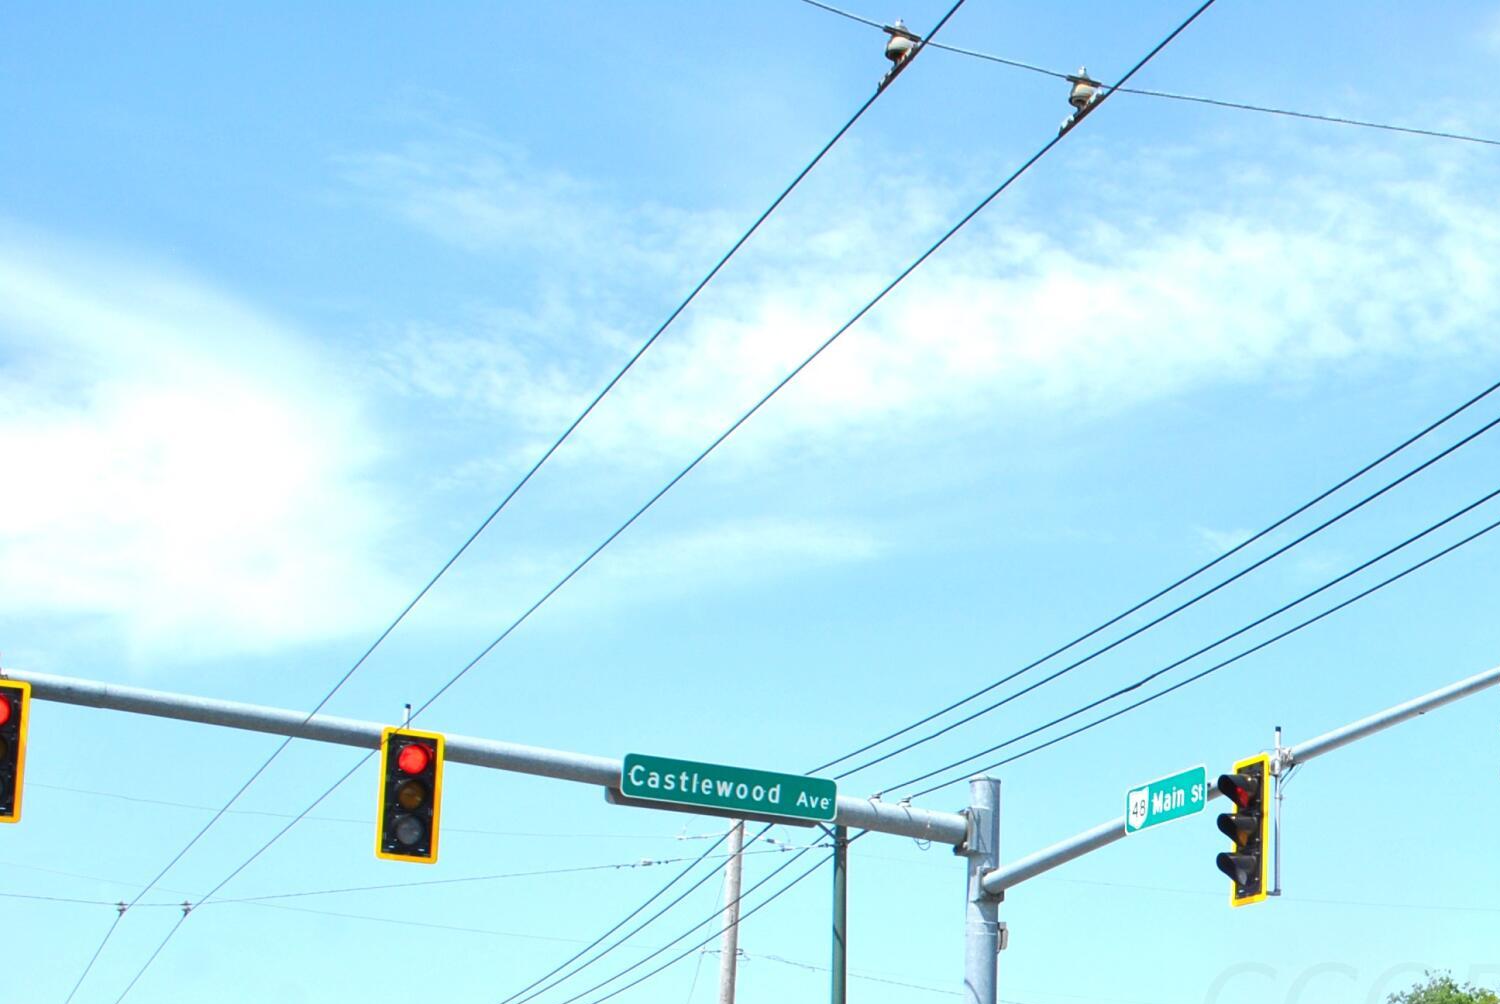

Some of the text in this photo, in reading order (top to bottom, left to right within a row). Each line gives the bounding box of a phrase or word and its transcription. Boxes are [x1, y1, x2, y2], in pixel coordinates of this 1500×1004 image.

[629, 764, 831, 810] Castlewood Ave
[1151, 784, 1204, 816] Main St
[1132, 800, 1146, 818] 48
